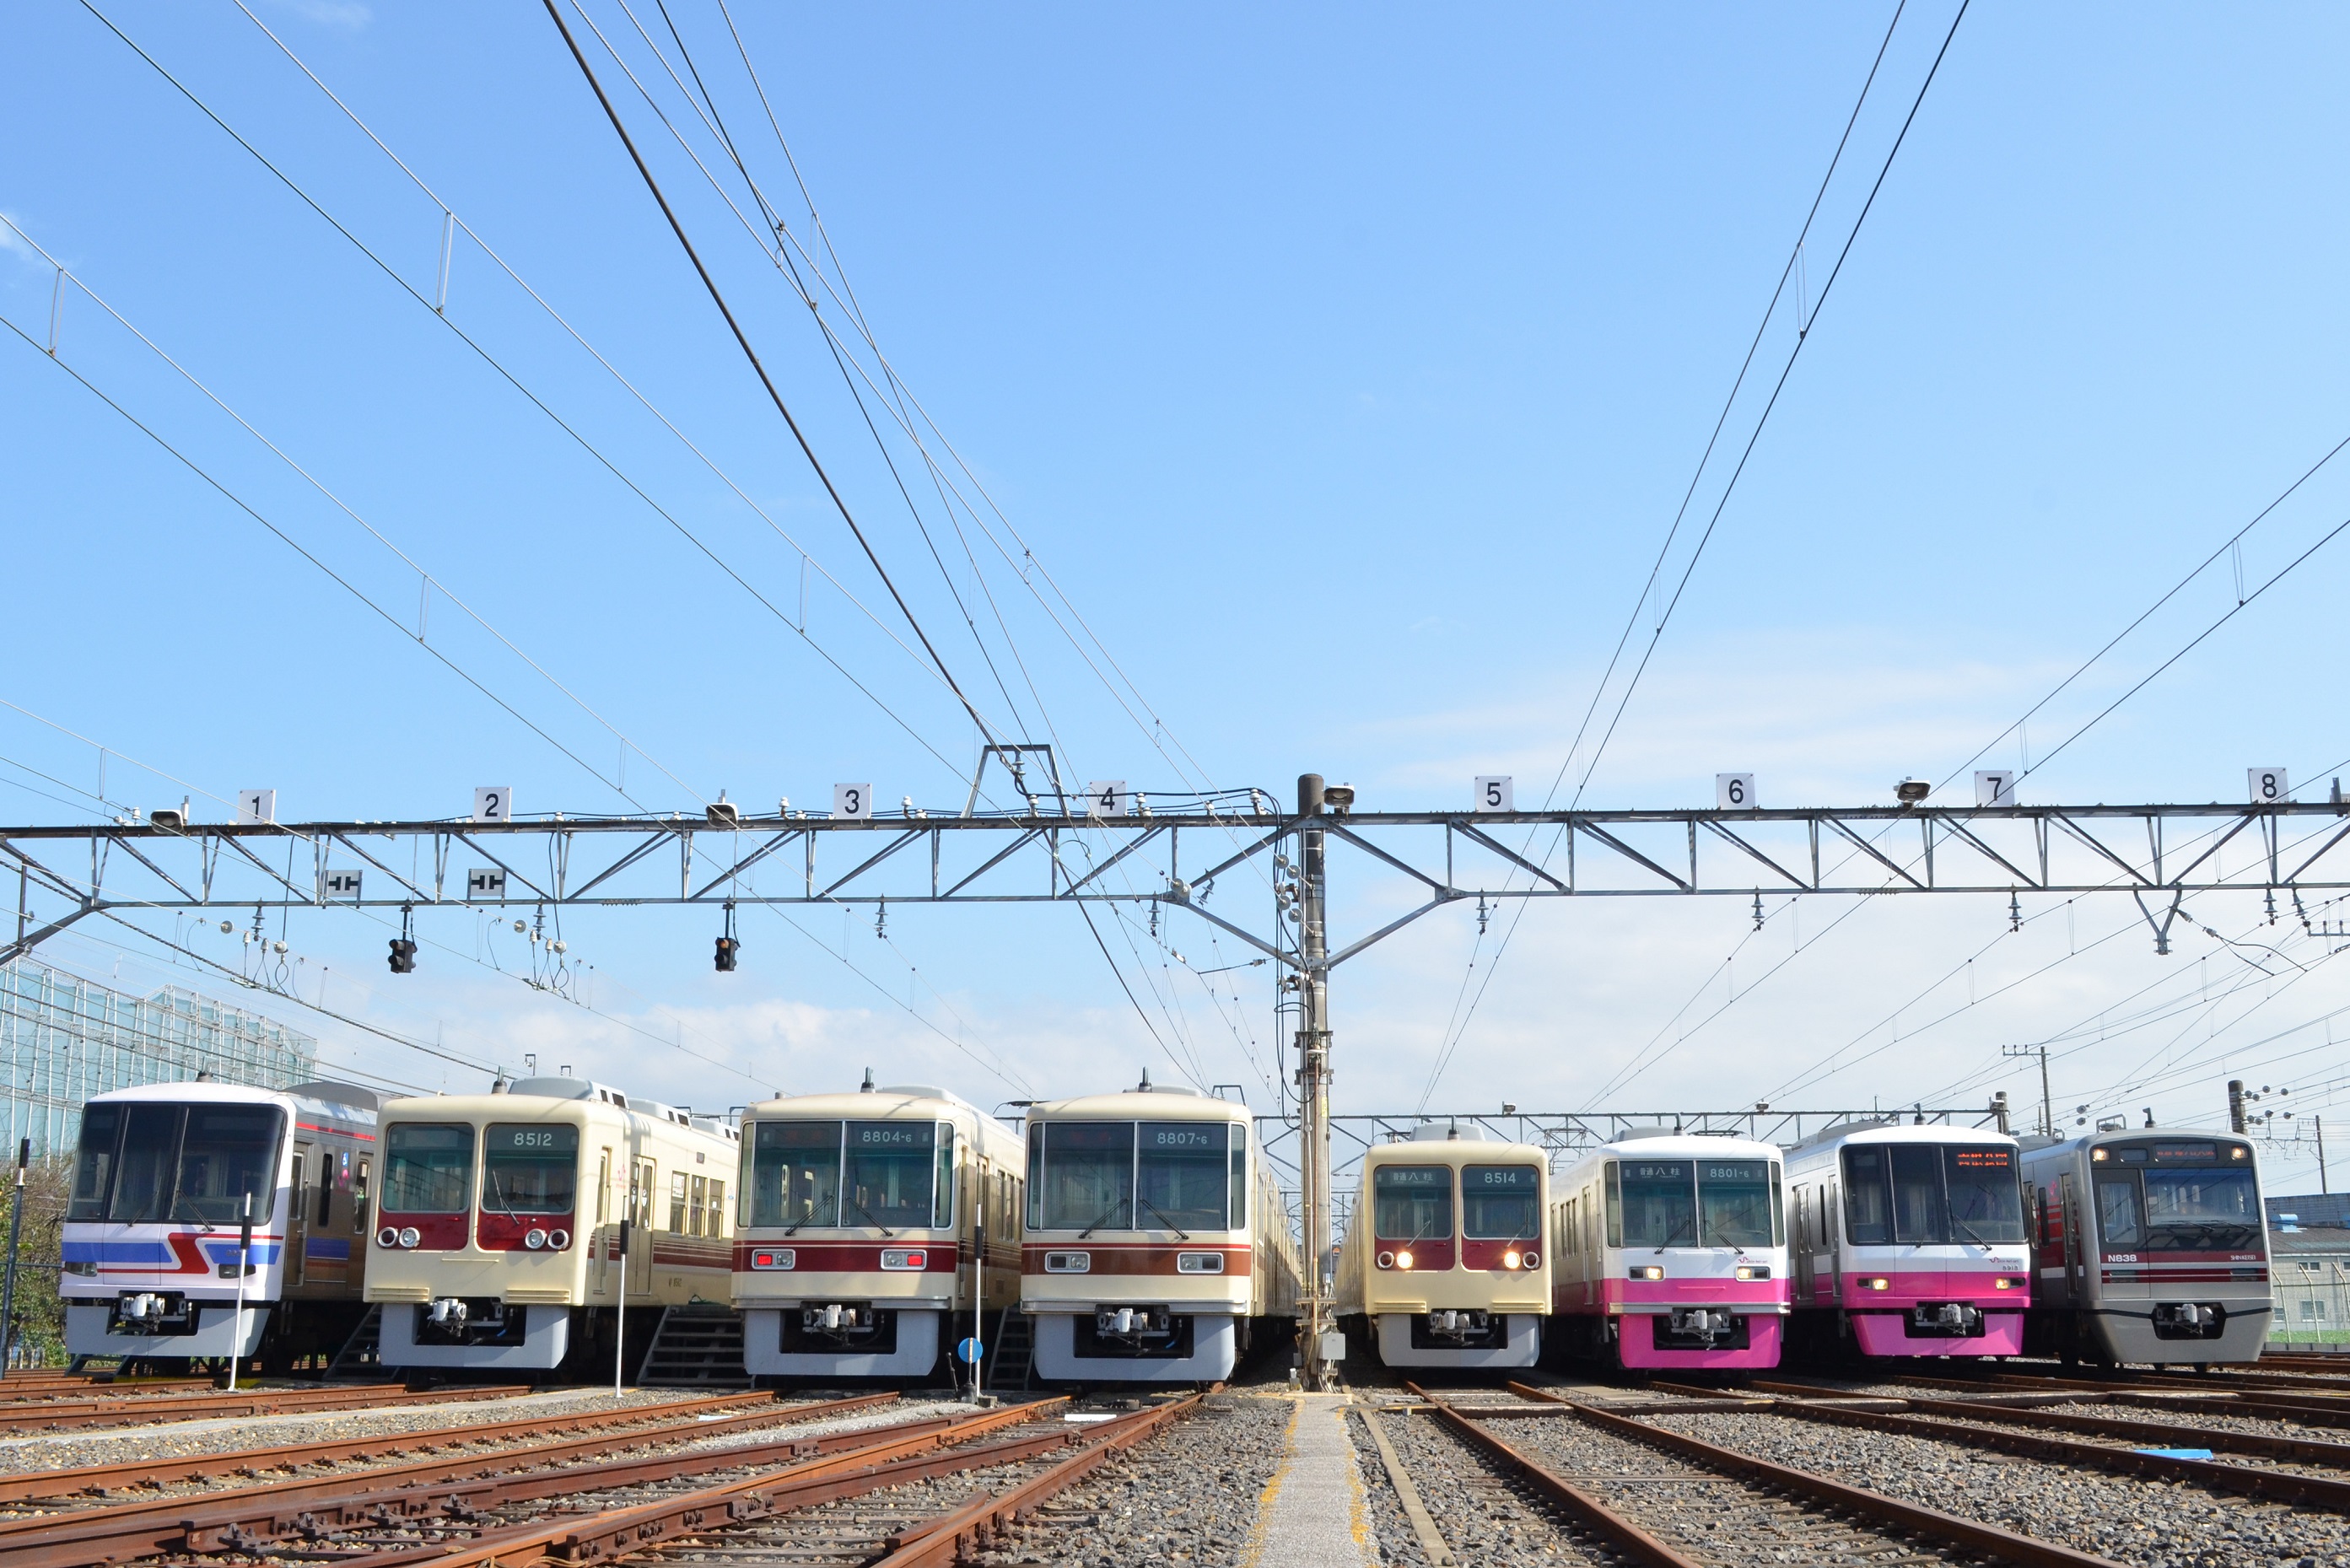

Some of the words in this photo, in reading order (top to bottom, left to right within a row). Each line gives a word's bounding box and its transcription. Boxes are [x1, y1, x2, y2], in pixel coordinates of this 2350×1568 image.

[1486, 782, 1501, 807] 5
[1728, 779, 1744, 805] 6
[1986, 777, 2002, 801] 7
[2261, 773, 2277, 799] 8
[251, 795, 260, 819] 1
[484, 793, 499, 817] 2
[844, 789, 860, 814] 3
[1101, 787, 1115, 811] 4
[515, 1133, 552, 1146] 8512
[863, 1131, 912, 1143] 8804-6
[1157, 1132, 1208, 1145] 8807-6
[1485, 1172, 1516, 1183] 8514
[1710, 1168, 1749, 1178] 8801-6
[2108, 1254, 2137, 1263] N838
